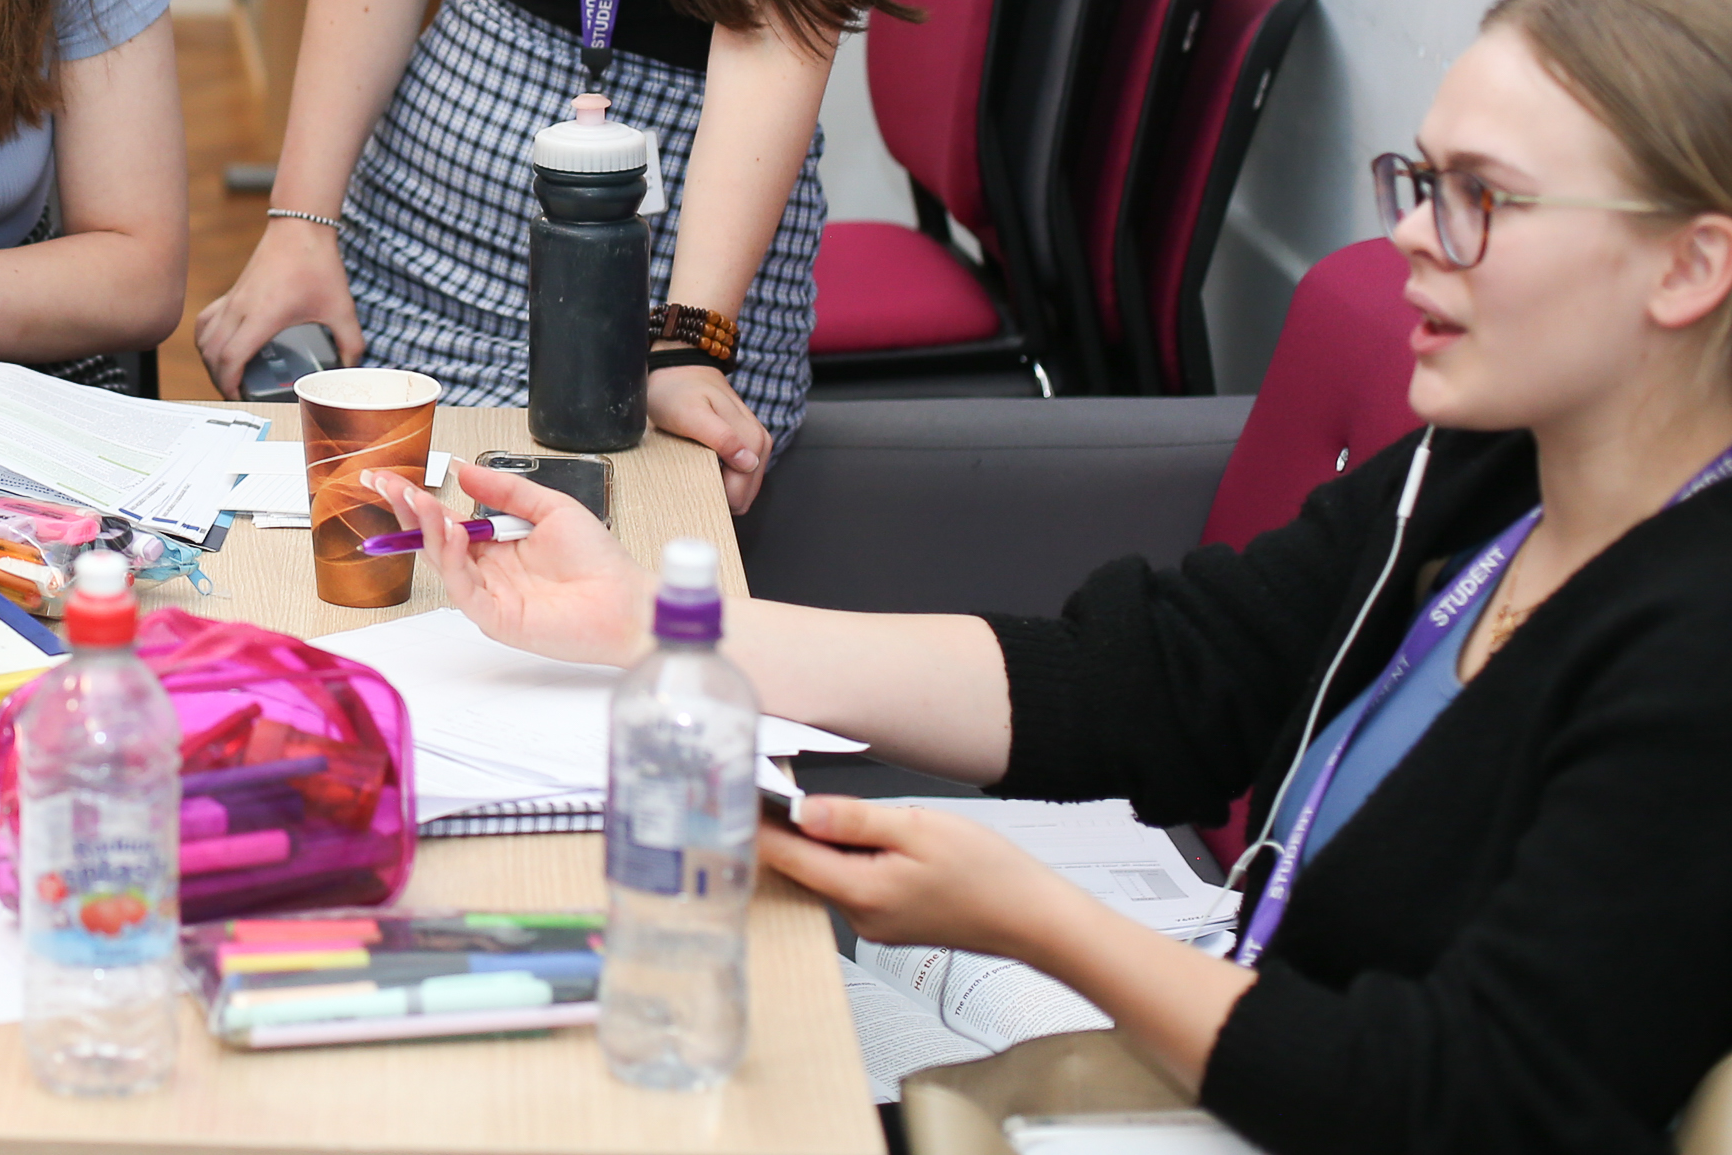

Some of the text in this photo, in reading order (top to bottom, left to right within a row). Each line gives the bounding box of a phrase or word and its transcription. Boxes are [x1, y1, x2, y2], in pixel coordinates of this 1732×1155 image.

[1429, 544, 1507, 629] STUDENT
[1268, 804, 1315, 901] STUDENT
[913, 953, 940, 992] Has the
[954, 999, 966, 1016] The
[963, 978, 983, 999] march
[981, 971, 991, 981] of
